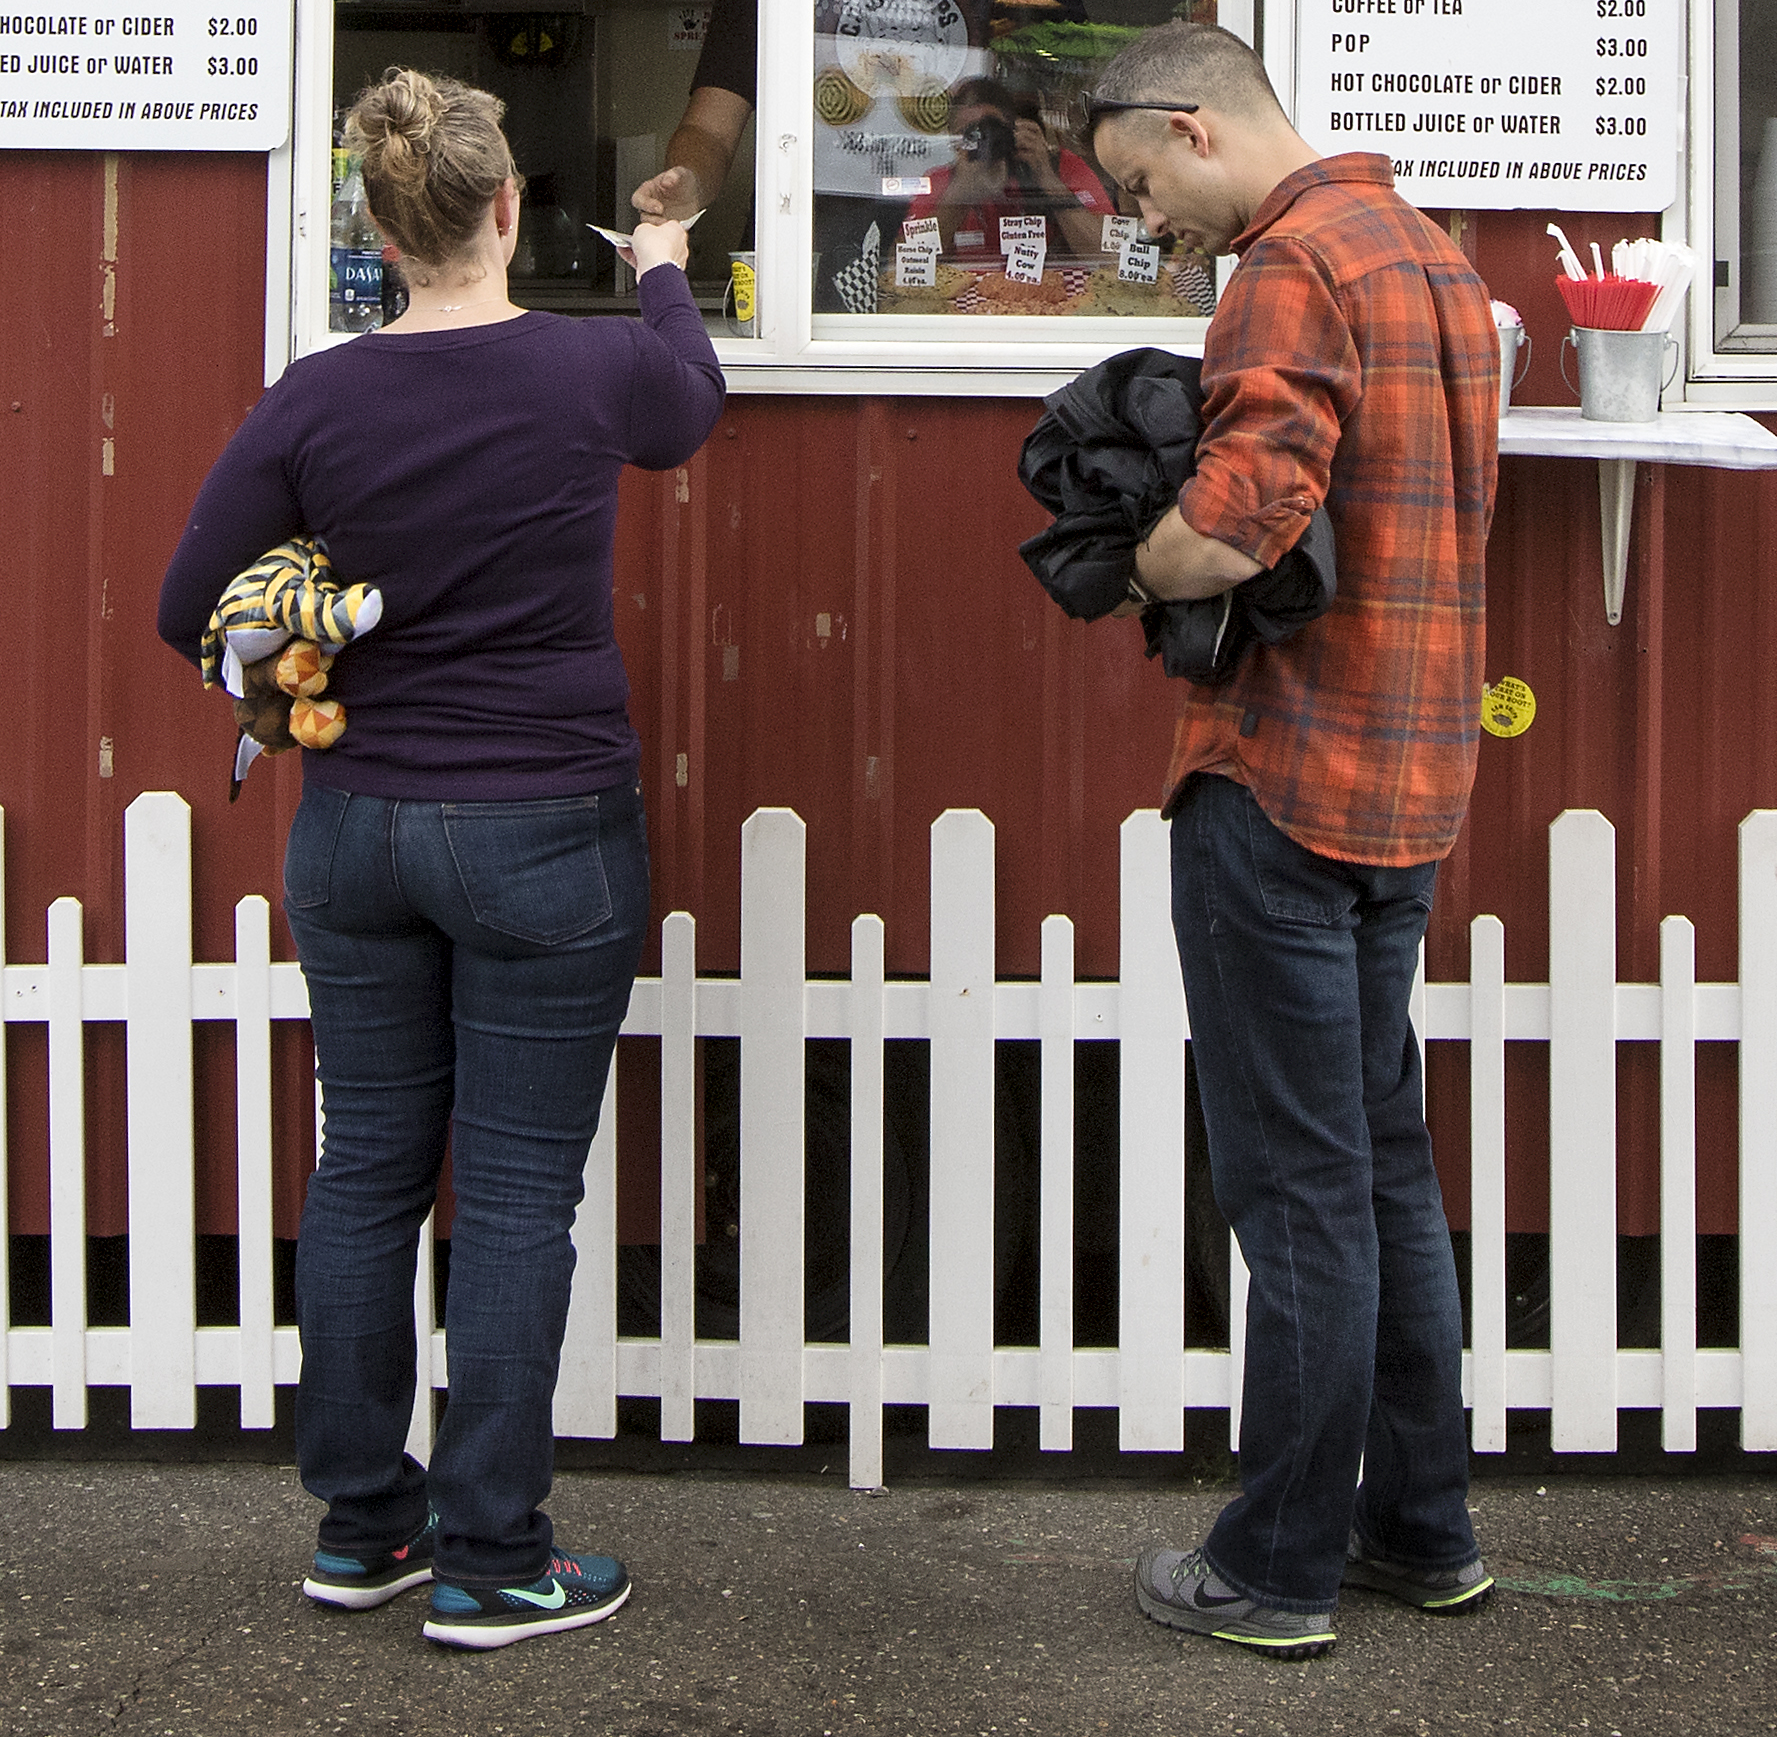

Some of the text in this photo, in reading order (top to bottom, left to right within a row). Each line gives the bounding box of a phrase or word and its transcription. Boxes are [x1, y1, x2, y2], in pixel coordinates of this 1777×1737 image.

[1597, 0, 1645, 18] $2.00
[95, 20, 114, 35] or
[123, 18, 173, 35] CIDER
[208, 18, 256, 36] $2.00
[1332, 34, 1646, 57] POP $3.00
[28, 55, 79, 73] JUICE
[88, 58, 107, 73] or
[115, 56, 172, 74] WATER
[208, 57, 257, 75] $3.00
[1332, 73, 1645, 96] HOT CHOCOLATE or CIDER $2.00
[1, 101, 28, 117] TAX
[34, 102, 112, 118] INCLUDED
[119, 103, 135, 118] IN
[141, 103, 194, 119] ABOVE
[200, 104, 258, 120] PRICES
[1130, 244, 1150, 254] Bull
[1128, 257, 1150, 270] Chip
